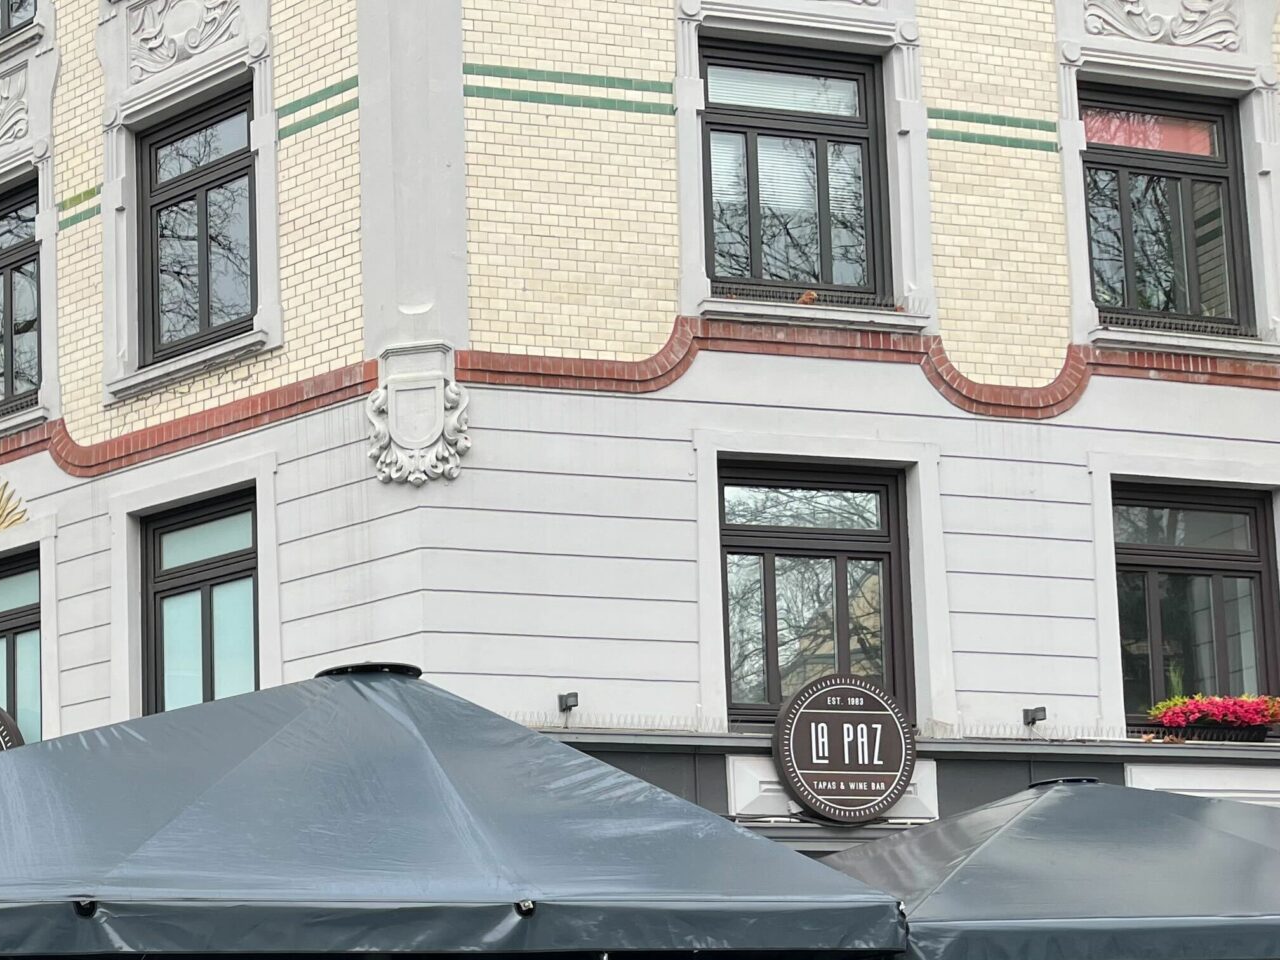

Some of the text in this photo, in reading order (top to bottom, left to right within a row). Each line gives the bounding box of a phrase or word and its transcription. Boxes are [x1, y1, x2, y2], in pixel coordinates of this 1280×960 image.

[827, 696, 844, 705] EST.
[810, 722, 884, 765] LA PAZ
[813, 781, 886, 791] TAPAS & WINE BAR
